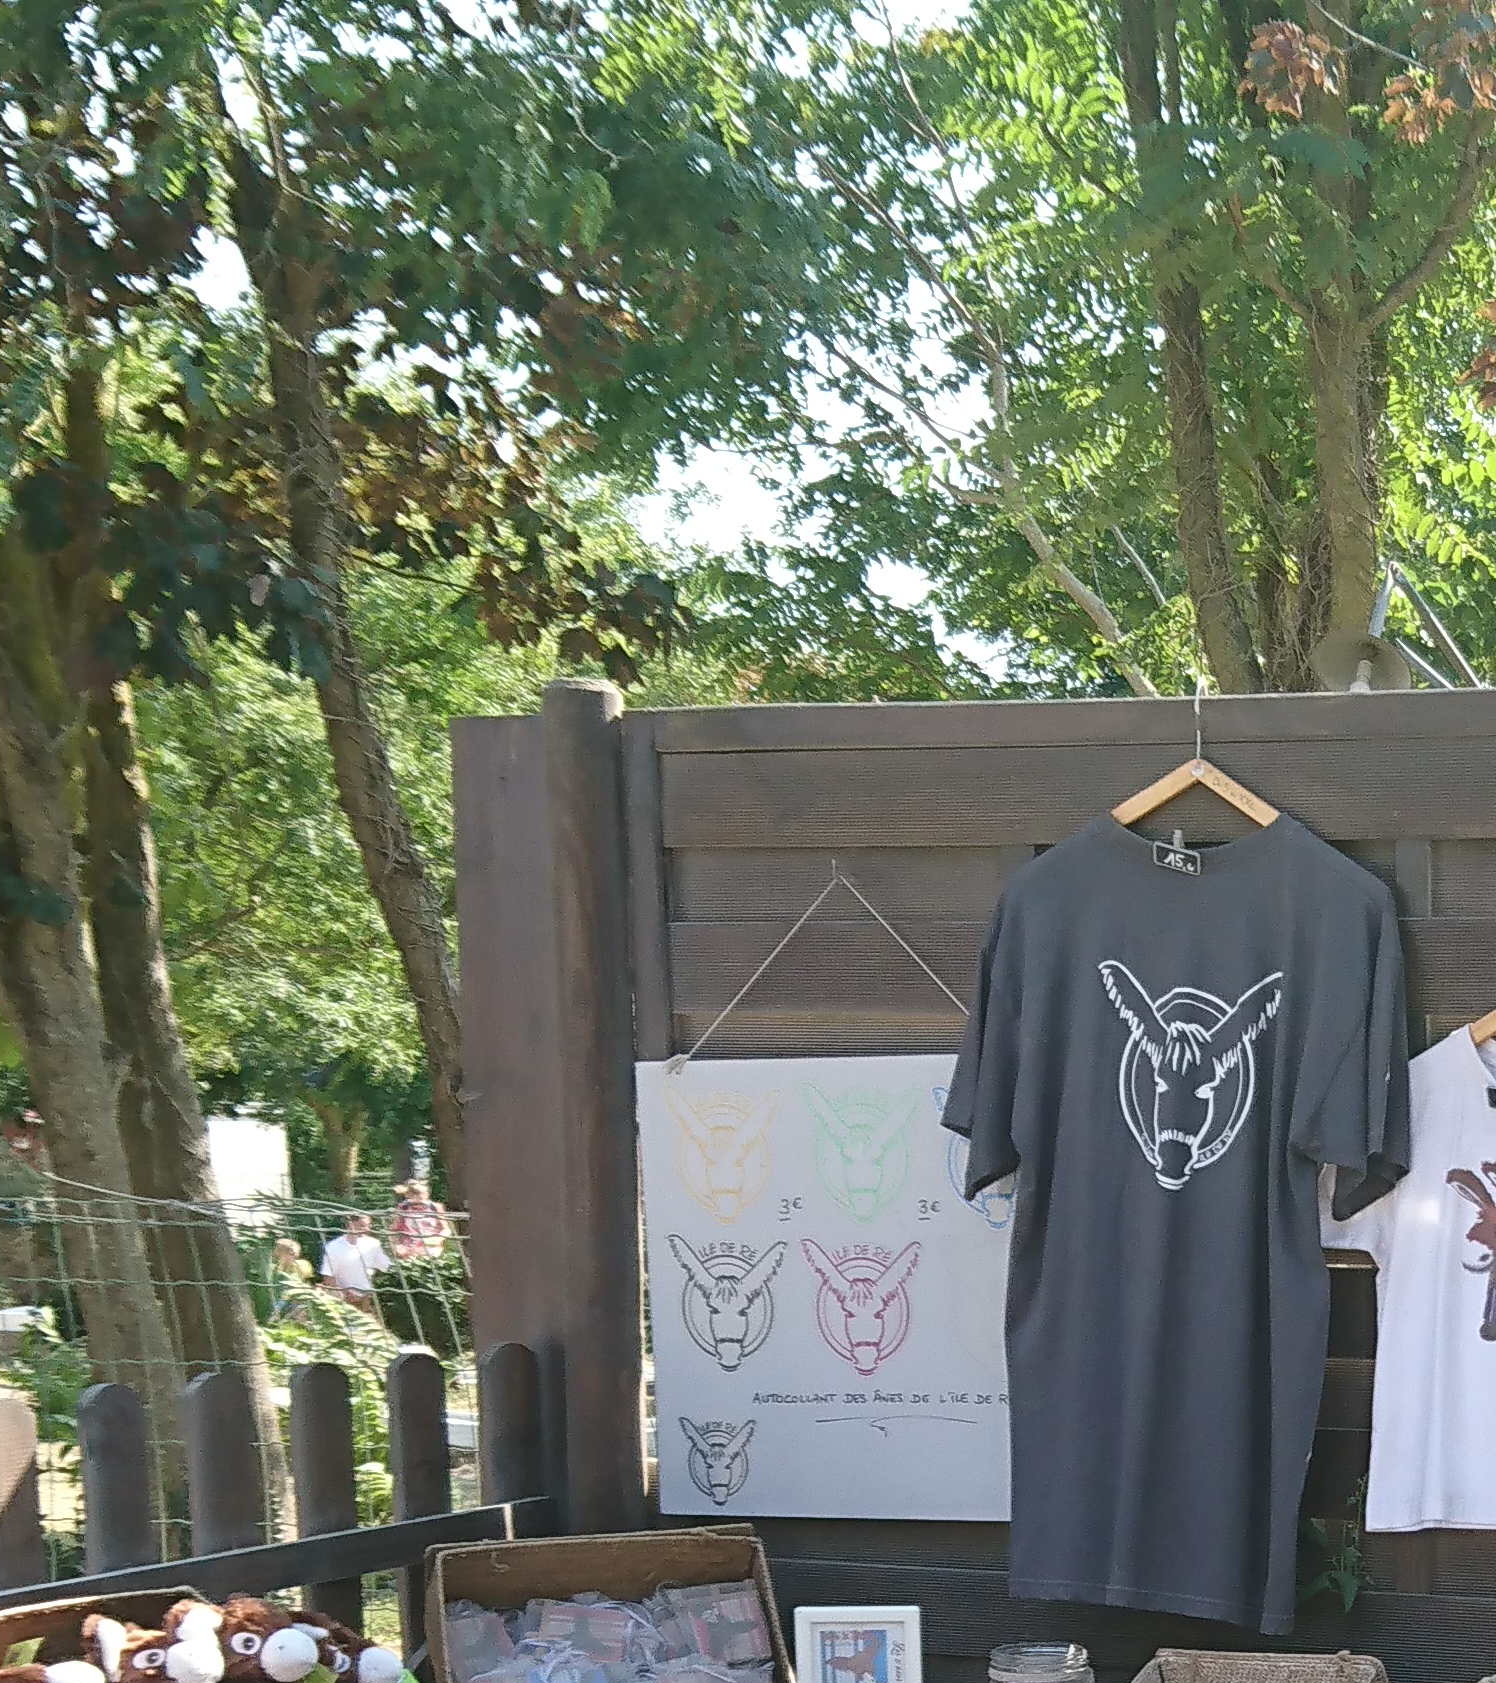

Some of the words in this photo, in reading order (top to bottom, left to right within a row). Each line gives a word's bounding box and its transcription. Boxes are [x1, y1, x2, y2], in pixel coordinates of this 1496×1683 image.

[753, 1392, 838, 1405] AUTOCOLLANT
[842, 1393, 867, 1404] DES
[973, 1394, 993, 1405] DE
